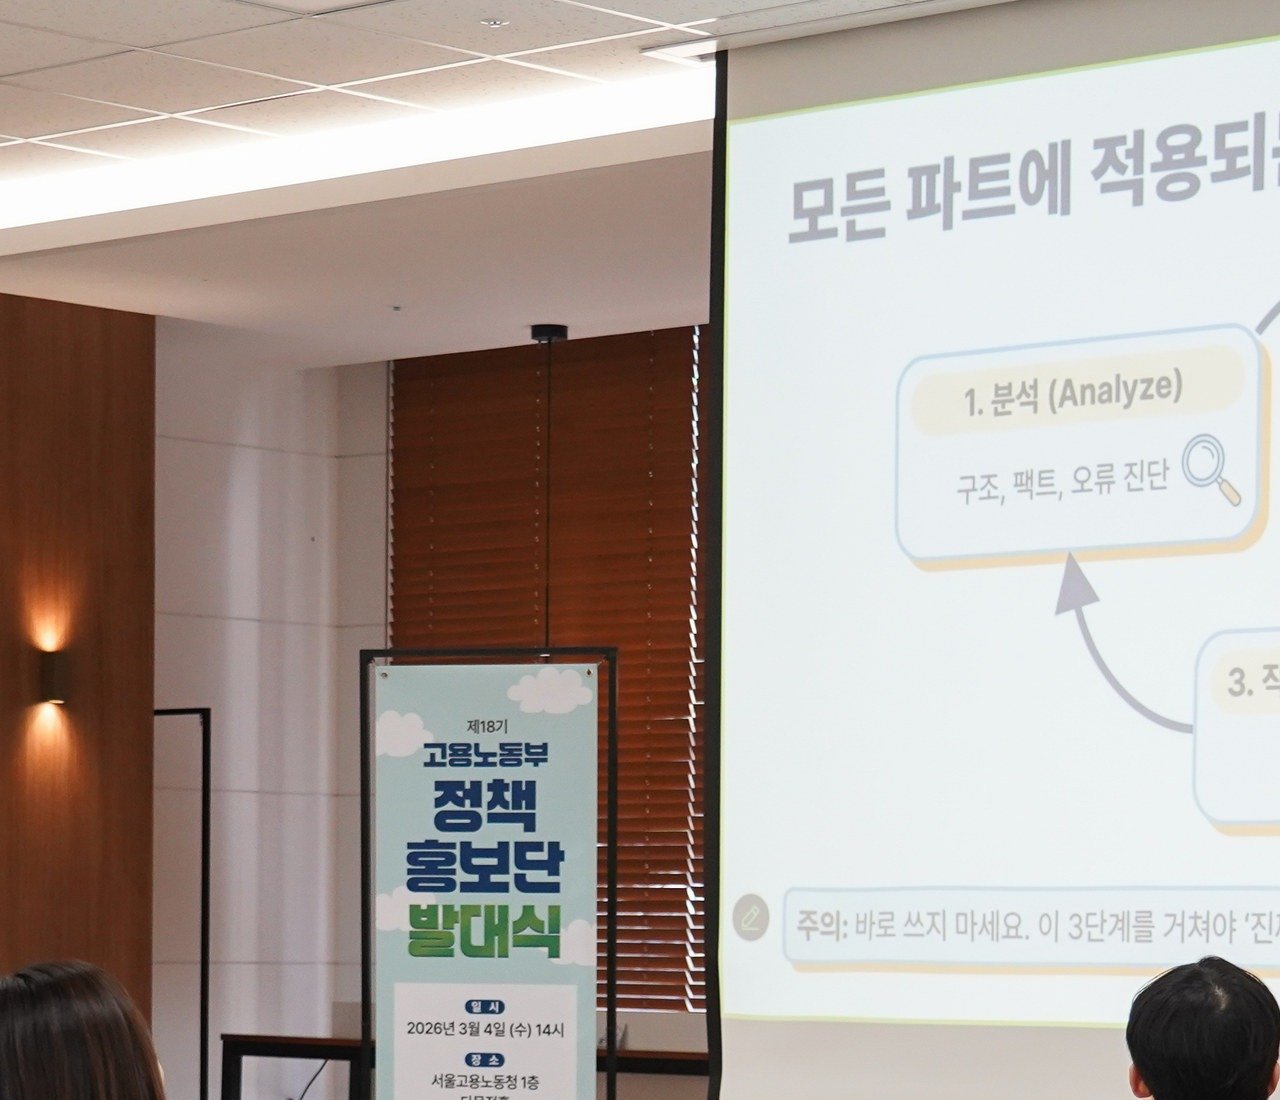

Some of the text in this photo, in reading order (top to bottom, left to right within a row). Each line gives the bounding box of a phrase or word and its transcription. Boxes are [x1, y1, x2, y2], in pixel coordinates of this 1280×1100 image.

[788, 168, 893, 245] 모든
[906, 138, 1073, 231] 파트에
[964, 367, 1183, 417] 1. 분석 (Analyze)
[957, 458, 1170, 506] 구조, 팩트, 오류 진단
[1227, 667, 1254, 697] 3.
[467, 719, 508, 734] 제18기
[423, 742, 549, 768] 고용노동부
[433, 778, 537, 833] 정책
[406, 839, 565, 894] 홍보단
[408, 904, 561, 959] 발대식
[797, 909, 848, 942] 주의:
[855, 909, 896, 941] 바로
[903, 909, 948, 942] 쓰지
[955, 909, 1030, 943] 마세요.
[1039, 910, 1060, 943] 이
[1068, 910, 1155, 944] 3단계를
[1163, 909, 1237, 944] 거쳐야
[407, 1021, 565, 1039] 2026년 3월 4일 (수) 14시
[431, 1074, 540, 1091] 서울고용노동청 1층
